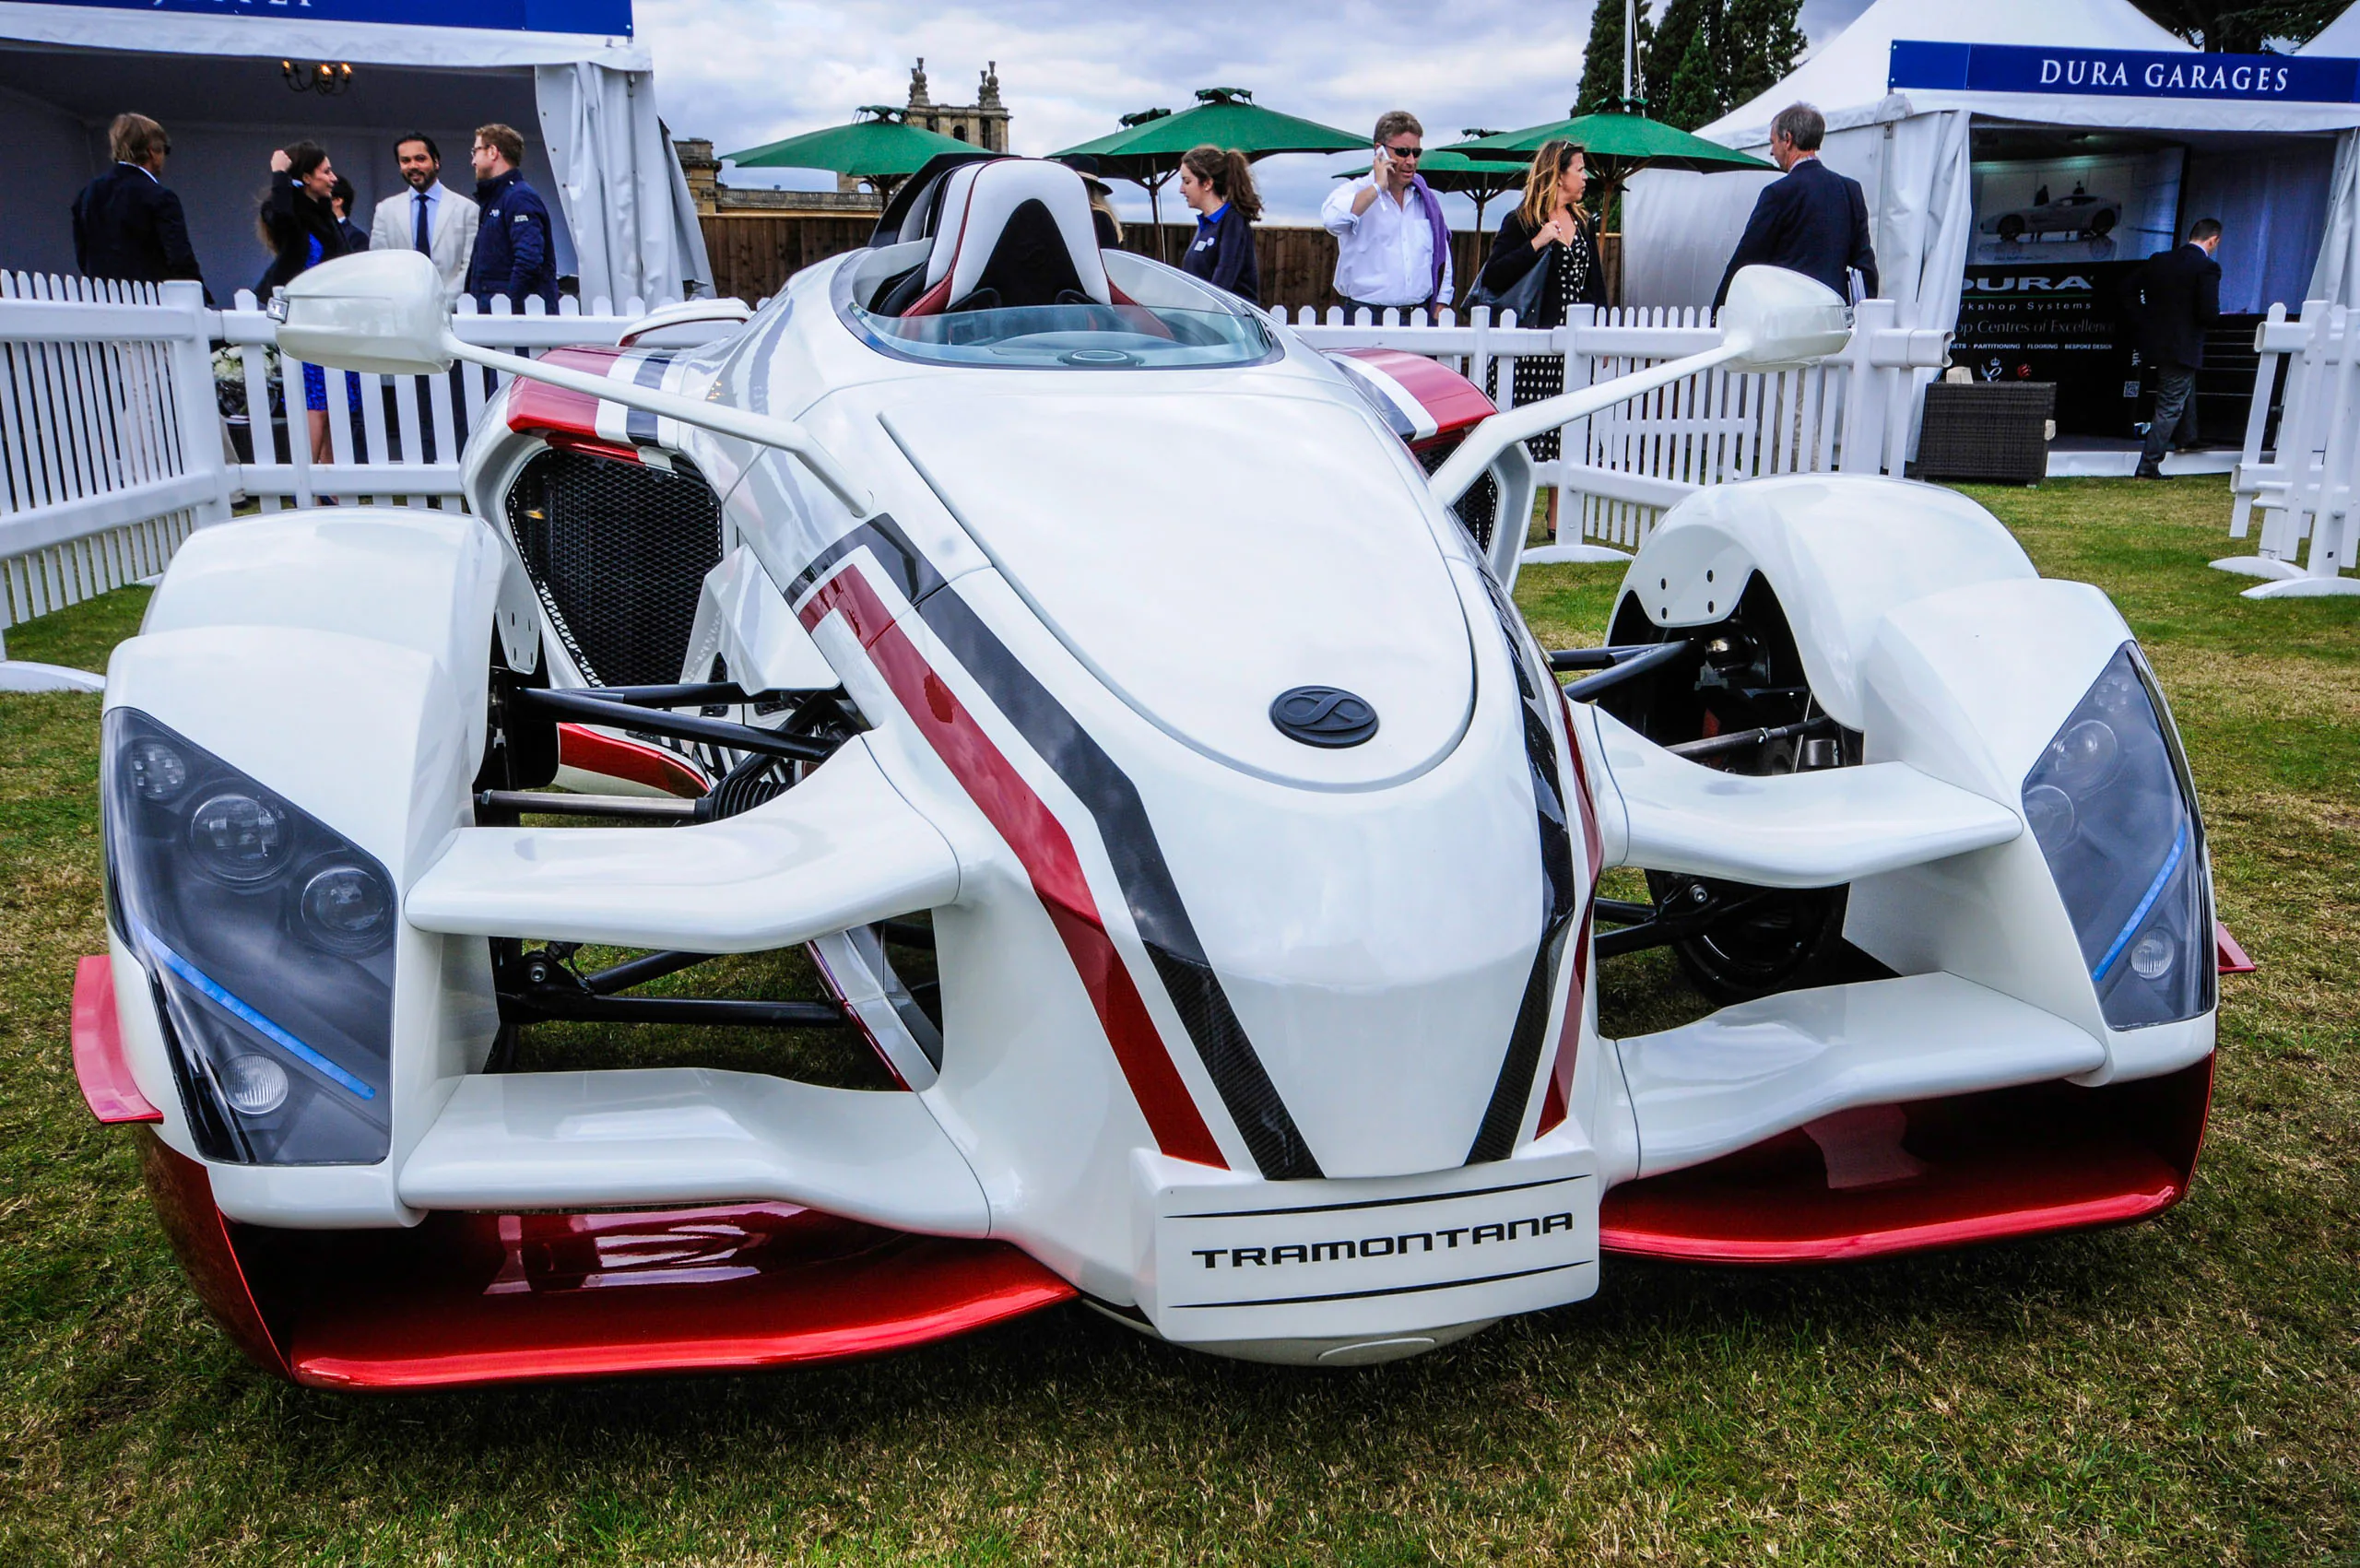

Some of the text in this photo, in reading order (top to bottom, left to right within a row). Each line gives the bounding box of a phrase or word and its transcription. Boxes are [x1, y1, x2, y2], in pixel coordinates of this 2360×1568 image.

[2039, 59, 2289, 91] DURA GARAGES
[2026, 301, 2092, 312] Systems
[1977, 319, 2030, 334] Centres
[1191, 1211, 1574, 1269] TRAMONTANA
